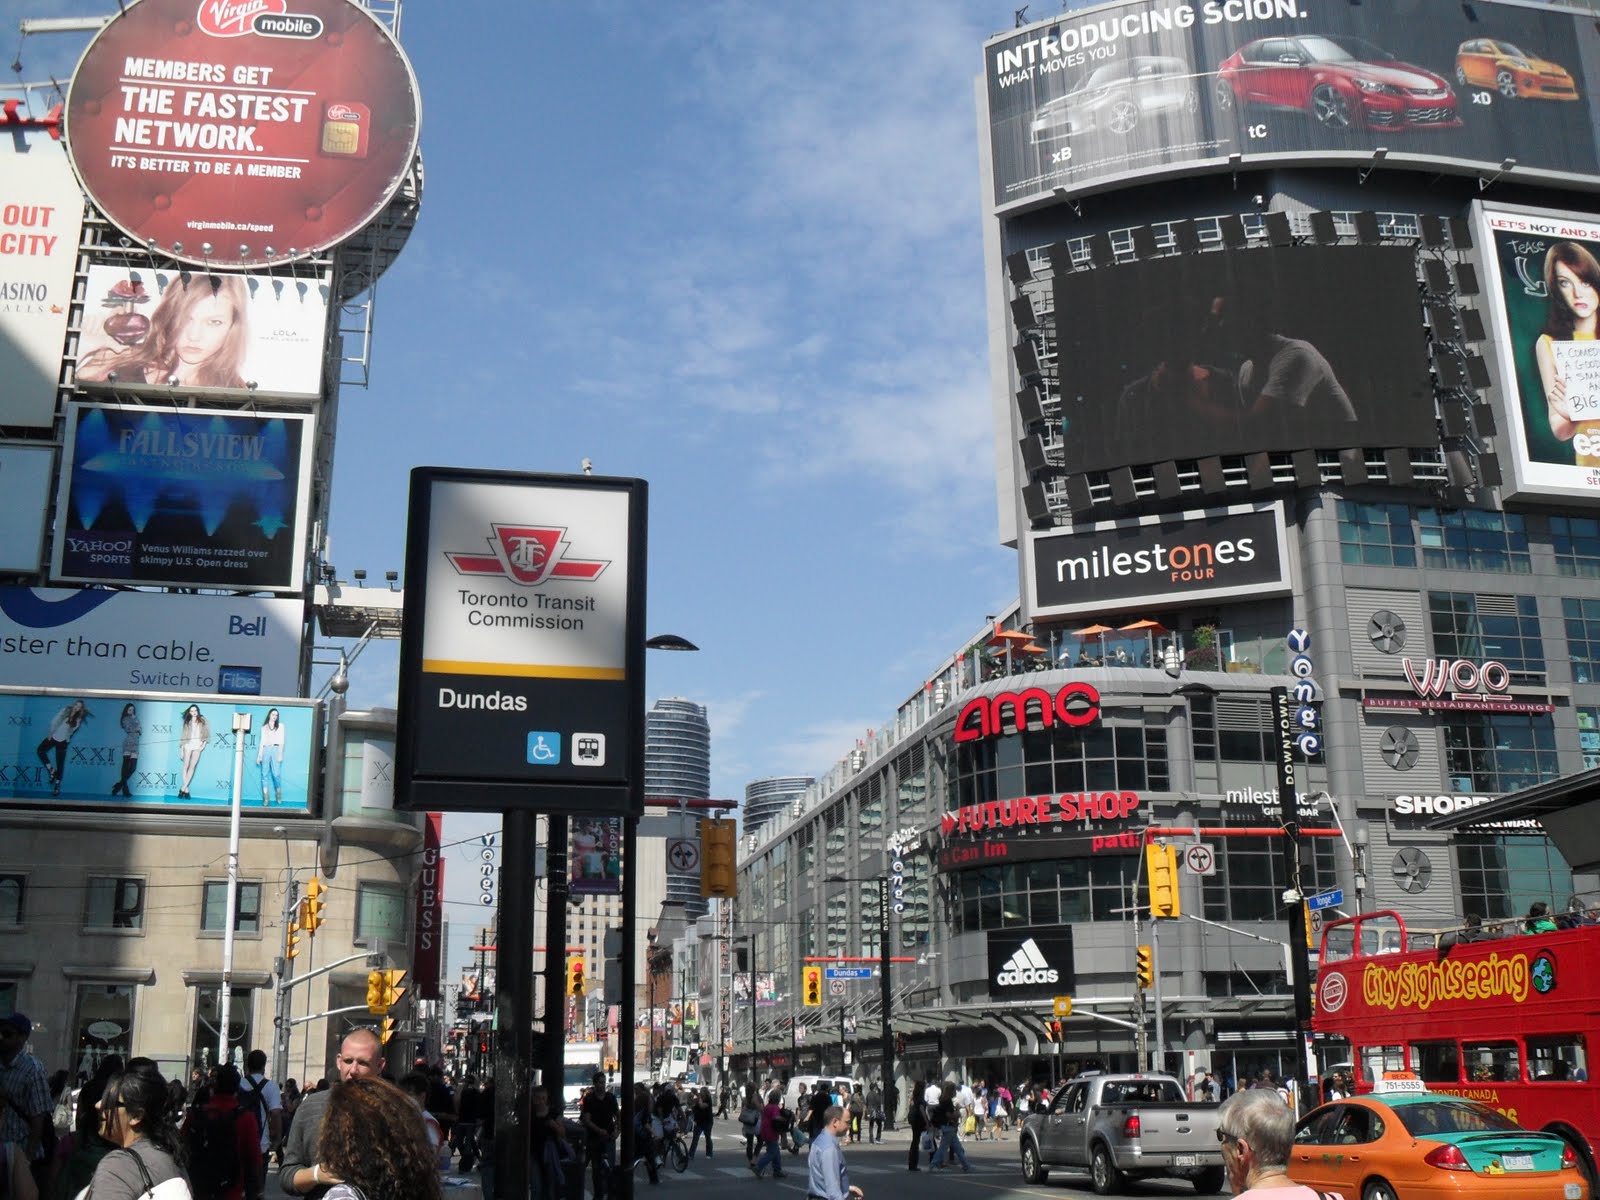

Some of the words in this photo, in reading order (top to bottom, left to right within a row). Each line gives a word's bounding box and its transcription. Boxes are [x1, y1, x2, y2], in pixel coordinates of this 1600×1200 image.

[209, 0, 268, 31] Virgin
[261, 18, 313, 34] mobile
[996, 6, 1196, 75] INTRODUCING
[1203, 0, 1308, 25] SCION.
[124, 56, 226, 83] MEMBERS
[233, 65, 273, 86] GET
[998, 65, 1036, 89] WHAT
[1040, 54, 1086, 74] MOVES
[1088, 44, 1117, 59] YOU
[121, 85, 175, 115] THE
[183, 91, 309, 123] FASTEST
[1471, 91, 1492, 106] xD
[114, 116, 264, 152] NETWORK.
[1248, 124, 1267, 139] tC
[1051, 147, 1073, 164] xB
[111, 155, 137, 169] IT'S
[140, 157, 190, 173] BETTER
[194, 160, 211, 174] TO
[214, 162, 231, 175] BE
[234, 163, 244, 175] A
[247, 164, 302, 179] MEMBER
[3, 204, 55, 228] OUT
[187, 220, 274, 233] virginmobile.ca/speed
[1490, 218, 1527, 231] LET'S
[1529, 223, 1557, 234] NOT
[1560, 227, 1587, 238] AND
[0, 233, 58, 257] CITY
[273, 329, 297, 337] LOLA
[119, 429, 265, 460] FALLSVIEW
[90, 554, 131, 564] SPORTS
[141, 543, 170, 554] Venus
[173, 545, 212, 556] Williams
[214, 547, 246, 558] razzed
[1056, 537, 1256, 582] milestones
[140, 556, 173, 567] skimpy
[176, 557, 194, 566] U.S.
[196, 558, 221, 569] Open
[224, 560, 249, 569] dress
[1171, 567, 1215, 583] FOUR
[458, 590, 528, 609] Toronto
[534, 593, 596, 612] Transit
[228, 614, 267, 637] Bell
[467, 609, 585, 631] Commission
[66, 635, 127, 658] than
[136, 640, 215, 663] cable.
[129, 669, 191, 687] Switch
[195, 674, 215, 688] to
[221, 673, 260, 690] Fibe
[1402, 658, 1511, 699] WOO
[438, 688, 528, 712] Dundas
[1421, 700, 1495, 710] RESTAURANT
[1503, 703, 1552, 712] LOUNGE
[151, 724, 173, 734] XXI
[1278, 694, 1295, 785] DOWNTOWN
[71, 746, 116, 762] XXI
[138, 772, 178, 786] XXI
[958, 795, 1053, 832] FUTURE
[1059, 792, 1140, 821] SHOP
[480, 833, 494, 906] Yonge
[420, 848, 437, 950] GUESS
[833, 969, 859, 977] Dundas
[997, 968, 1059, 986] adidas
[1385, 1081, 1421, 1090] 751-5555
[1462, 1088, 1500, 1104] CANADA
